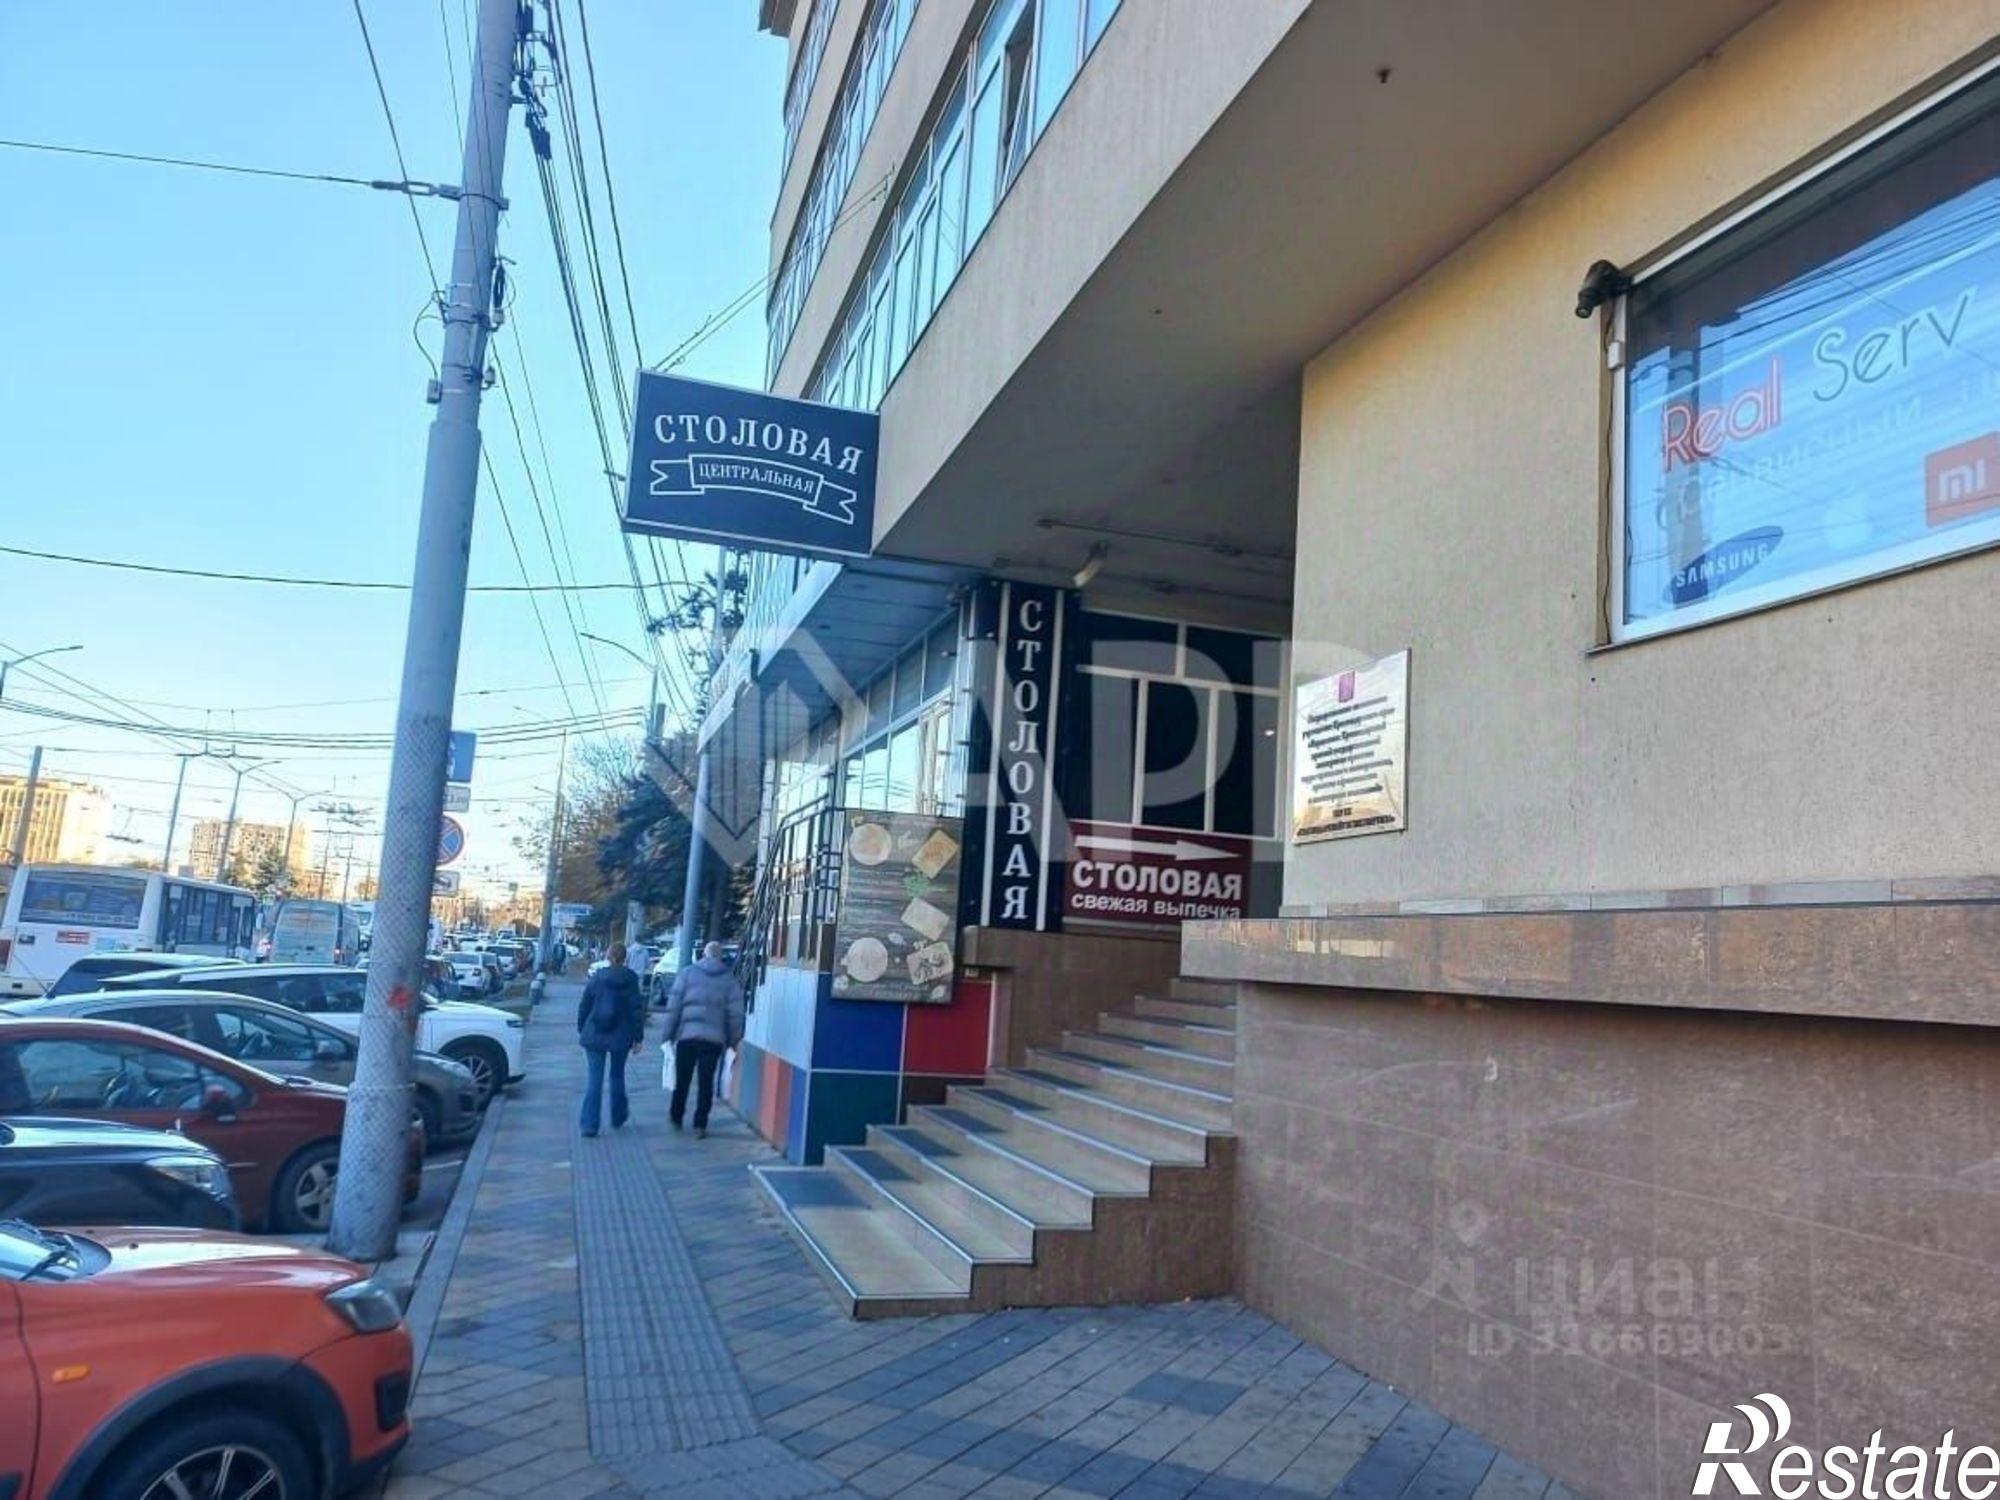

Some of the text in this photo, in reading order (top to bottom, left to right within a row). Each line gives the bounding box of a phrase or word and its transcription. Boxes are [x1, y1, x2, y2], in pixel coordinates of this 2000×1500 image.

[1662, 290, 1972, 474] Real Serv
[654, 414, 864, 475] СТОЛОВАЯ
[699, 462, 814, 493] ЦЕНТРАЛЬНАЯ
[1676, 543, 1769, 588] SAMSUNG
[1000, 600, 1043, 919] СТОЛОВАЯ
[1072, 859, 1243, 901] СТОЛОВАЯ
[1071, 893, 1241, 919] свежая выпечка
